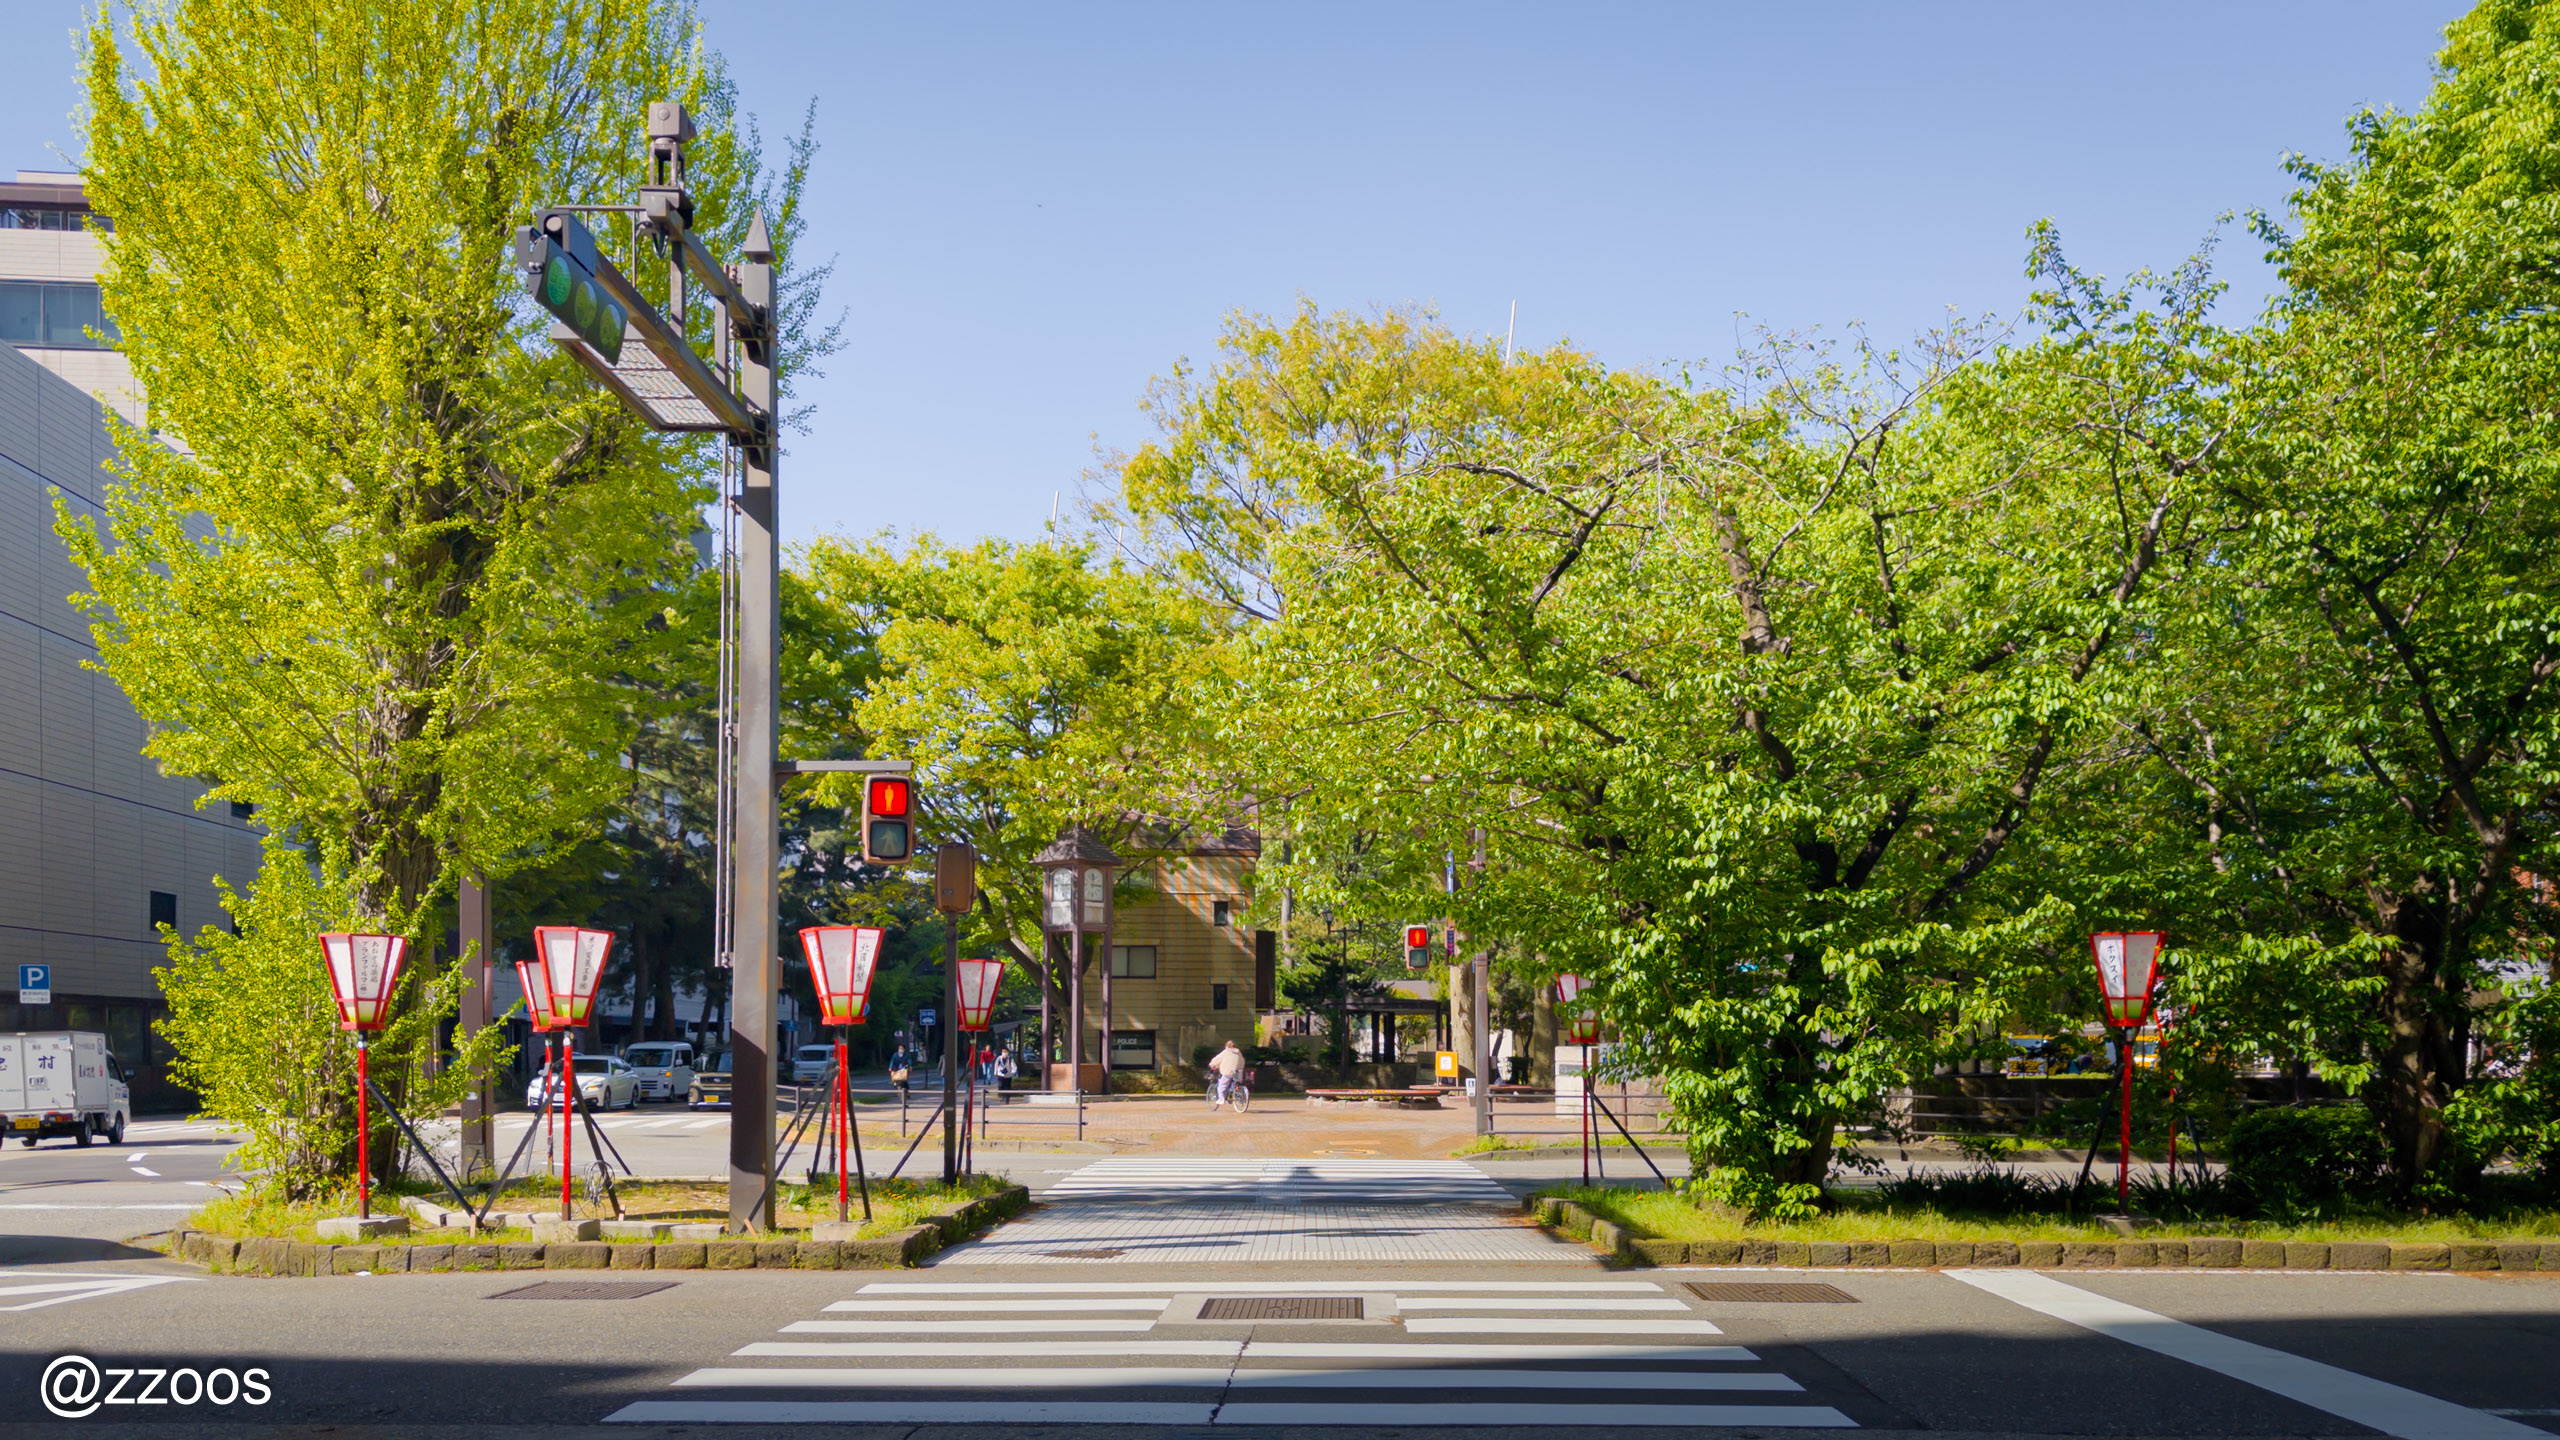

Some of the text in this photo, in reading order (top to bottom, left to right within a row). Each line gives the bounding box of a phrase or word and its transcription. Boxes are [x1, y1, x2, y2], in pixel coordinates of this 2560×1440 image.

[2107, 945, 2118, 984] ホクスイ
[27, 967, 45, 987] P
[38, 1055, 56, 1070] 村
